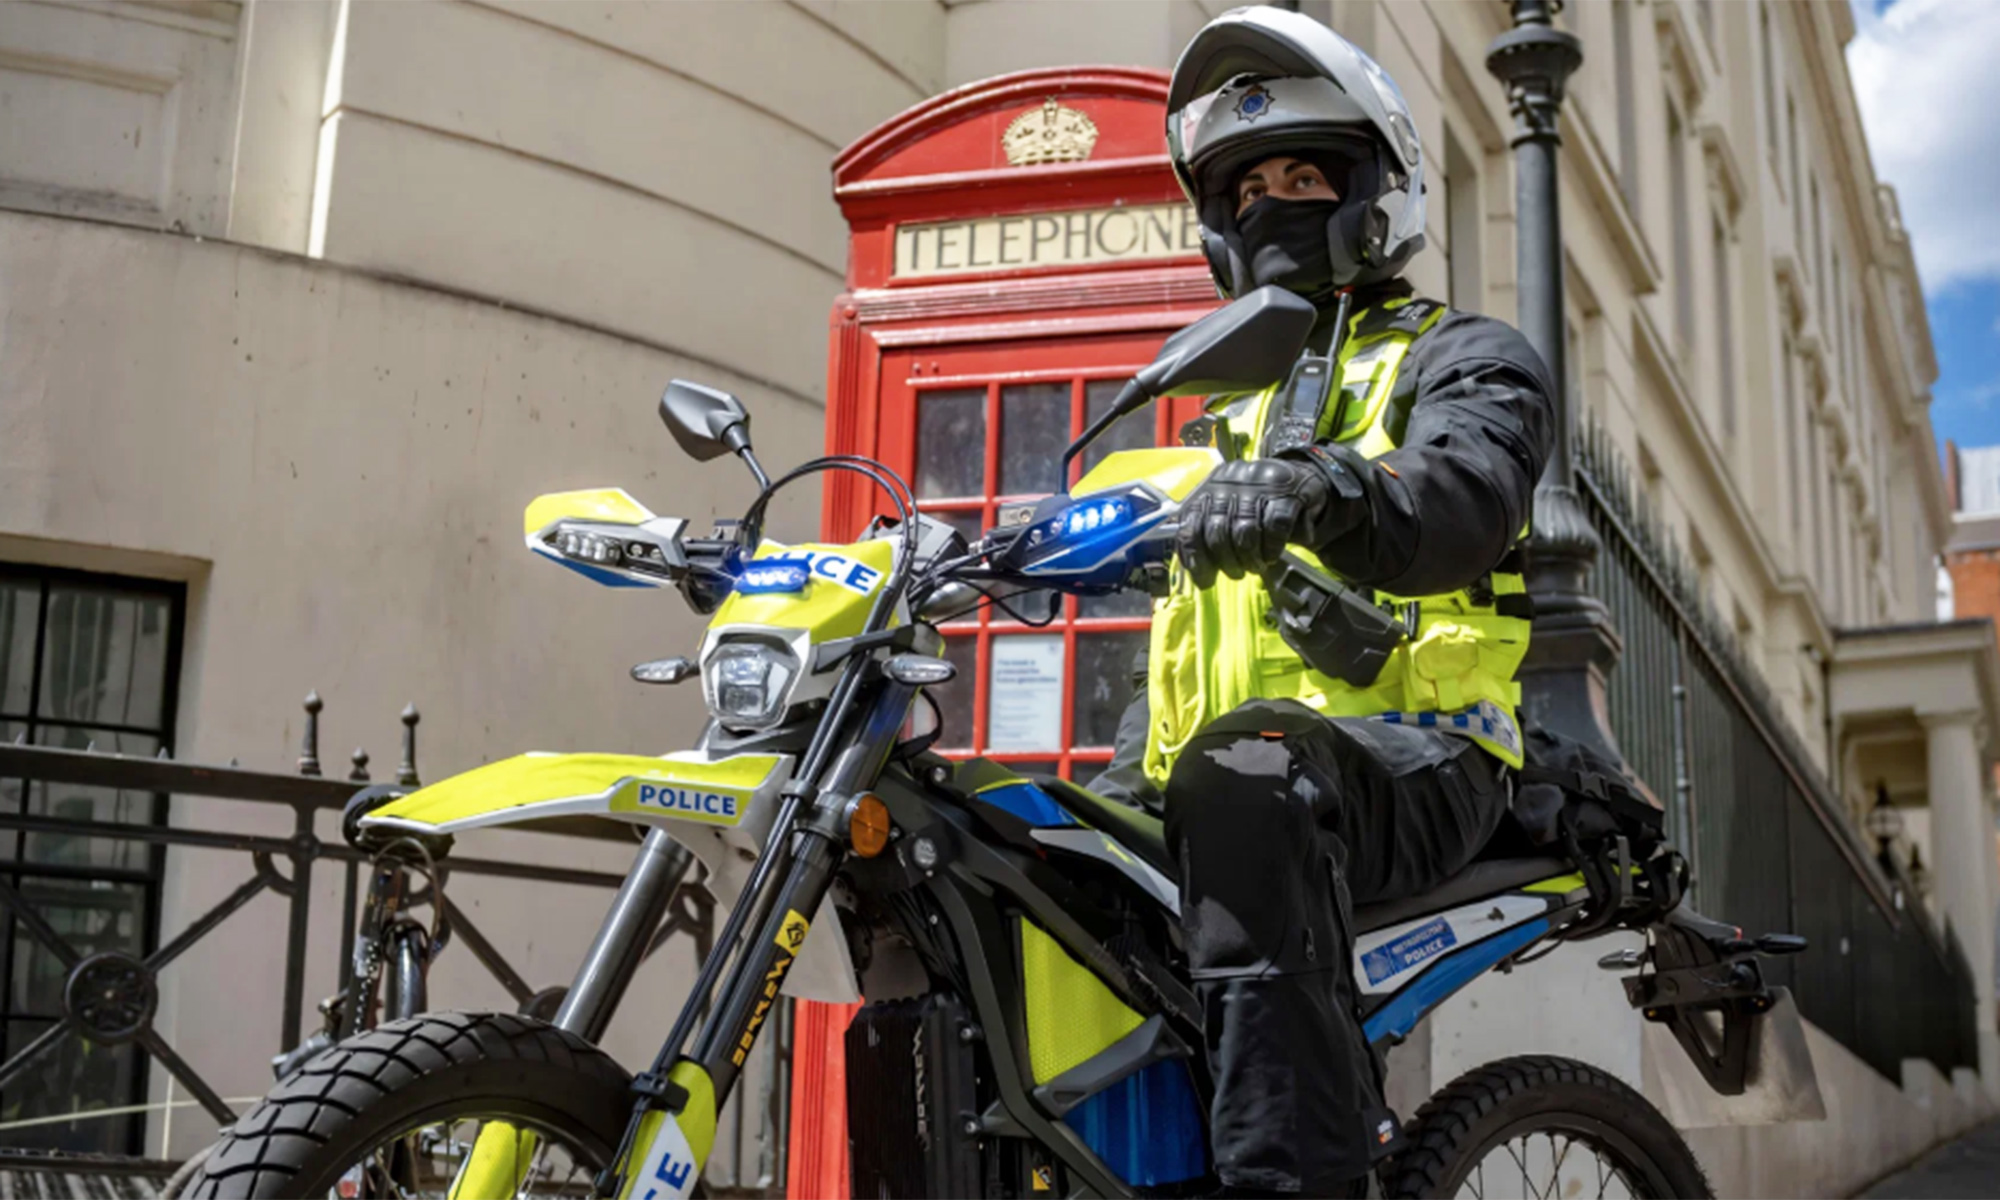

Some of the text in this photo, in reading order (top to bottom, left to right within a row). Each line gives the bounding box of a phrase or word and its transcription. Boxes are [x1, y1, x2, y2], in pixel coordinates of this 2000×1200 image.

[902, 205, 1200, 270] TELEPHONE
[639, 784, 737, 816] POLICE
[1404, 938, 1445, 965] POLICE
